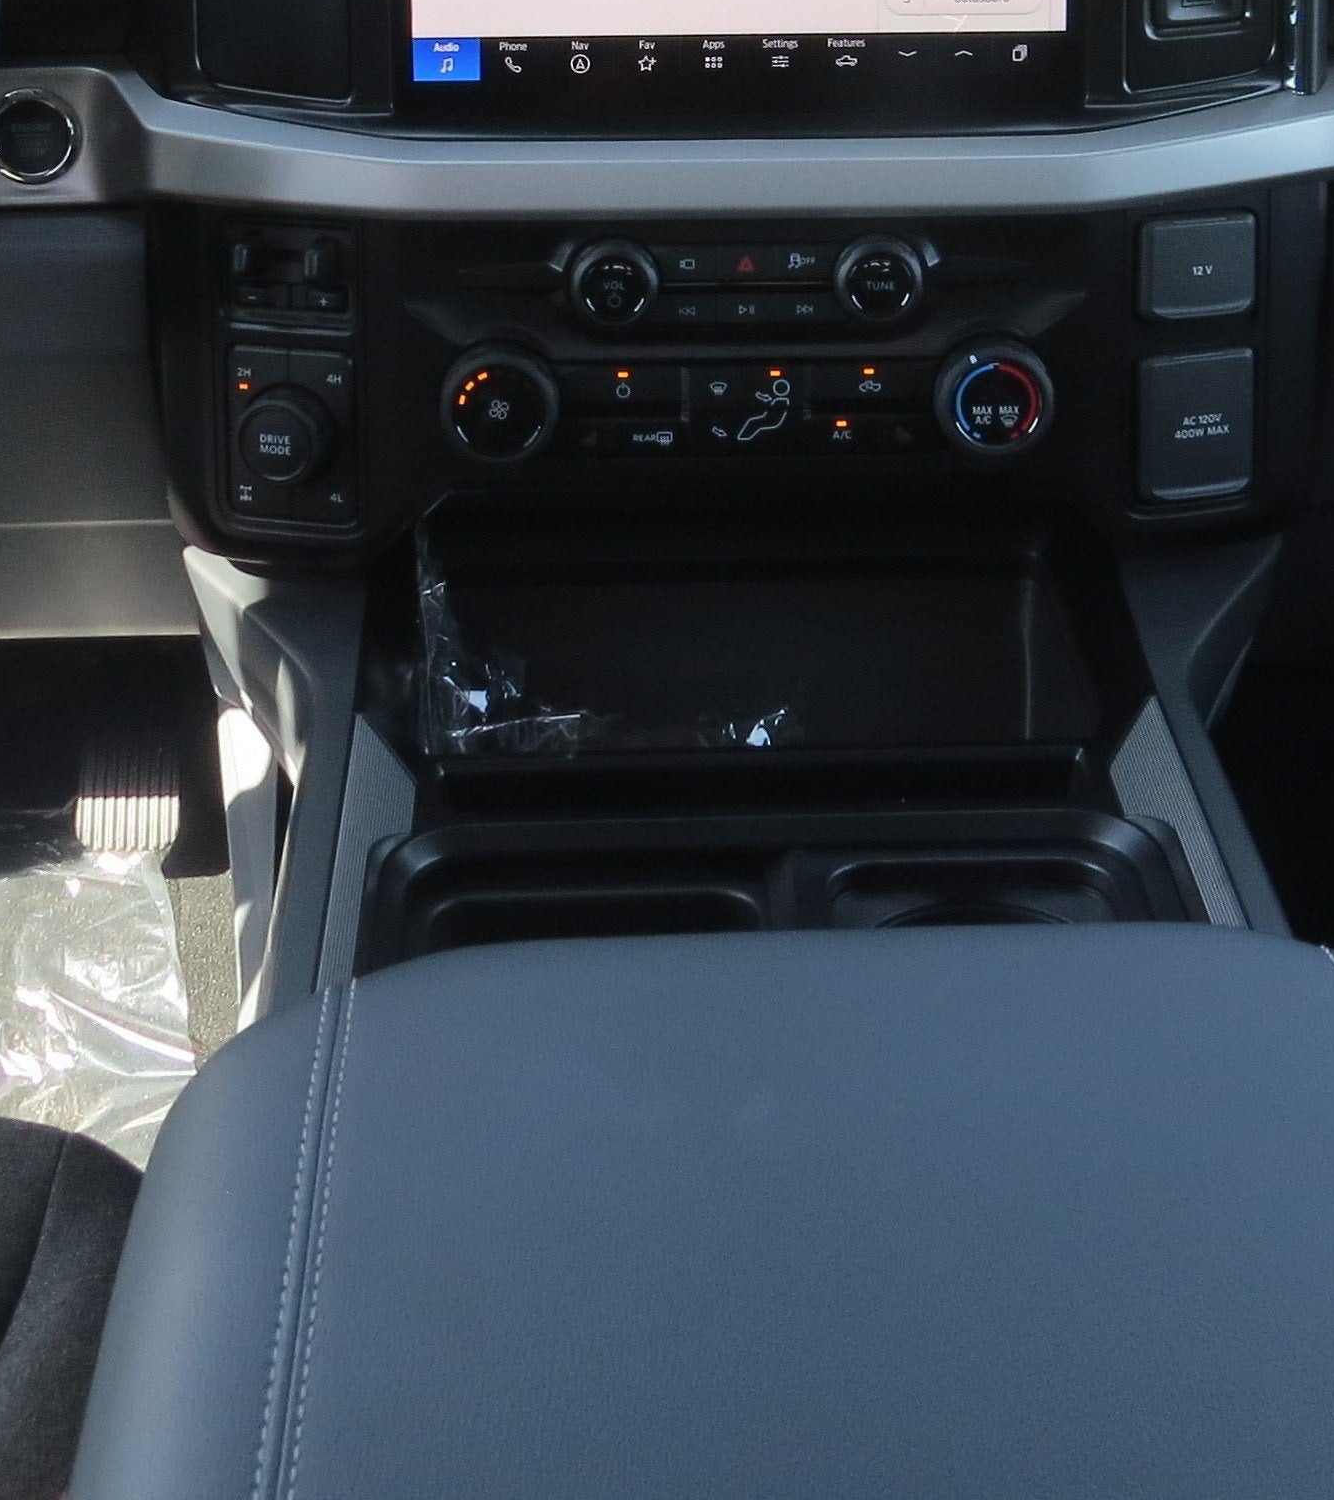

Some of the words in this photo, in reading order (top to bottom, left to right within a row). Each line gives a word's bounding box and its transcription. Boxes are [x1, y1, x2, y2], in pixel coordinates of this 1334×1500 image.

[433, 42, 460, 53] Audio
[499, 41, 528, 52] Phone
[571, 40, 589, 51] Nav
[638, 40, 656, 51] Fav
[702, 39, 726, 51] Apps
[762, 38, 799, 50] Settings
[827, 37, 866, 48] Features
[801, 256, 816, 266] OFF
[1192, 266, 1204, 276] 12
[1205, 265, 1213, 275] V
[603, 280, 624, 291] VOL
[867, 280, 895, 291] TUNE
[237, 368, 251, 377] 2H
[326, 374, 342, 384] 4H
[972, 406, 993, 416] MAX
[998, 406, 1019, 415] MAX
[975, 415, 991, 425] A/C
[1182, 416, 1197, 426] AC
[1198, 413, 1223, 424] 120V
[833, 431, 852, 440] A/C
[1174, 428, 1205, 439] 400W
[1207, 424, 1230, 435] MAX
[259, 433, 291, 445] DRIVE
[633, 433, 656, 442] REAR
[259, 444, 291, 456] MODE
[330, 493, 344, 503] 4L
